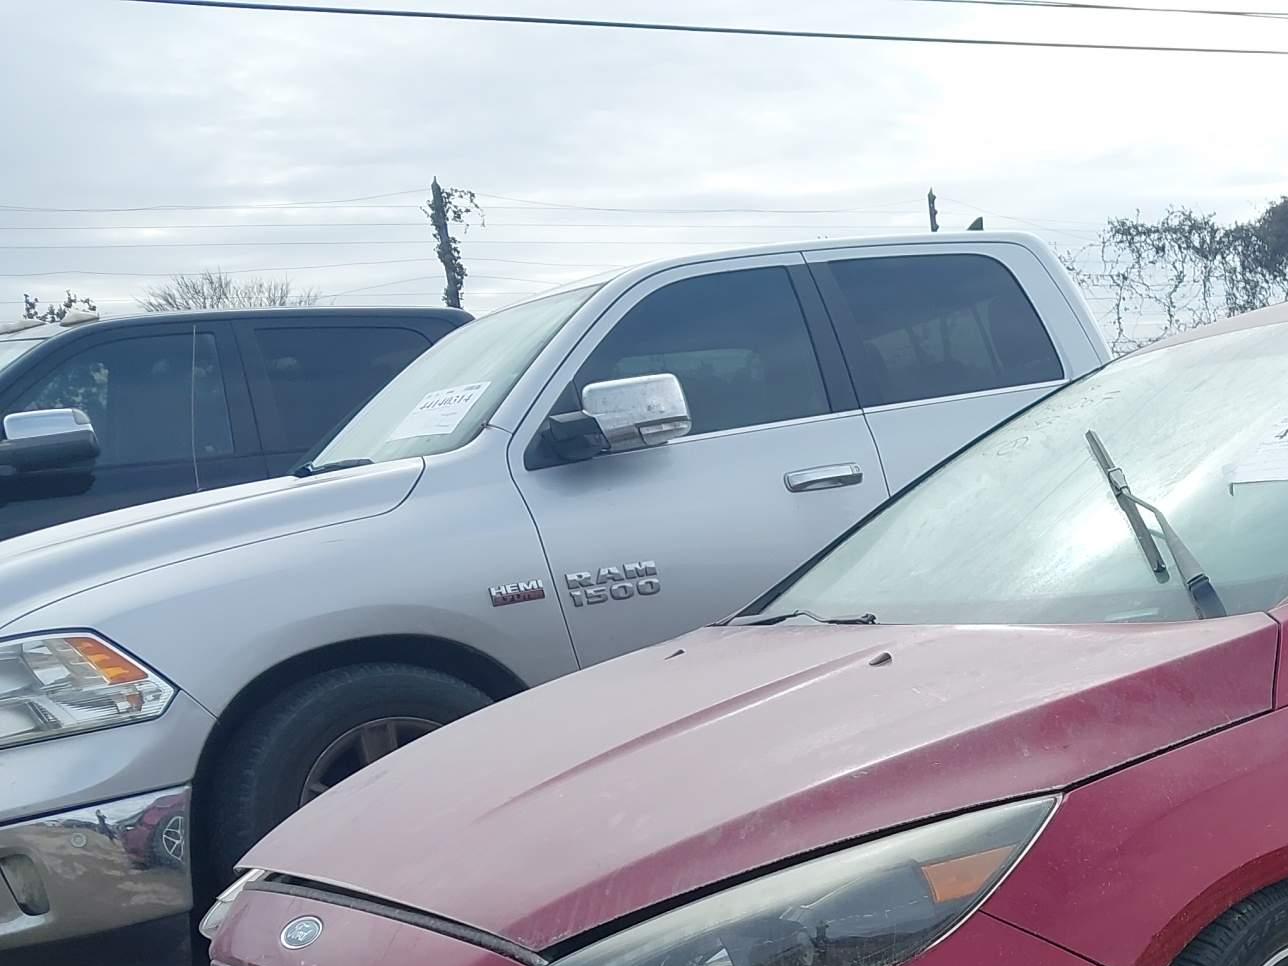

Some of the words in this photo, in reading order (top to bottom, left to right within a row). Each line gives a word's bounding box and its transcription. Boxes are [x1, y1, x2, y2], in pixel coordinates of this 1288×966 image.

[488, 579, 543, 596] HEMI
[564, 560, 657, 590] RAM
[569, 578, 661, 608] 1500
